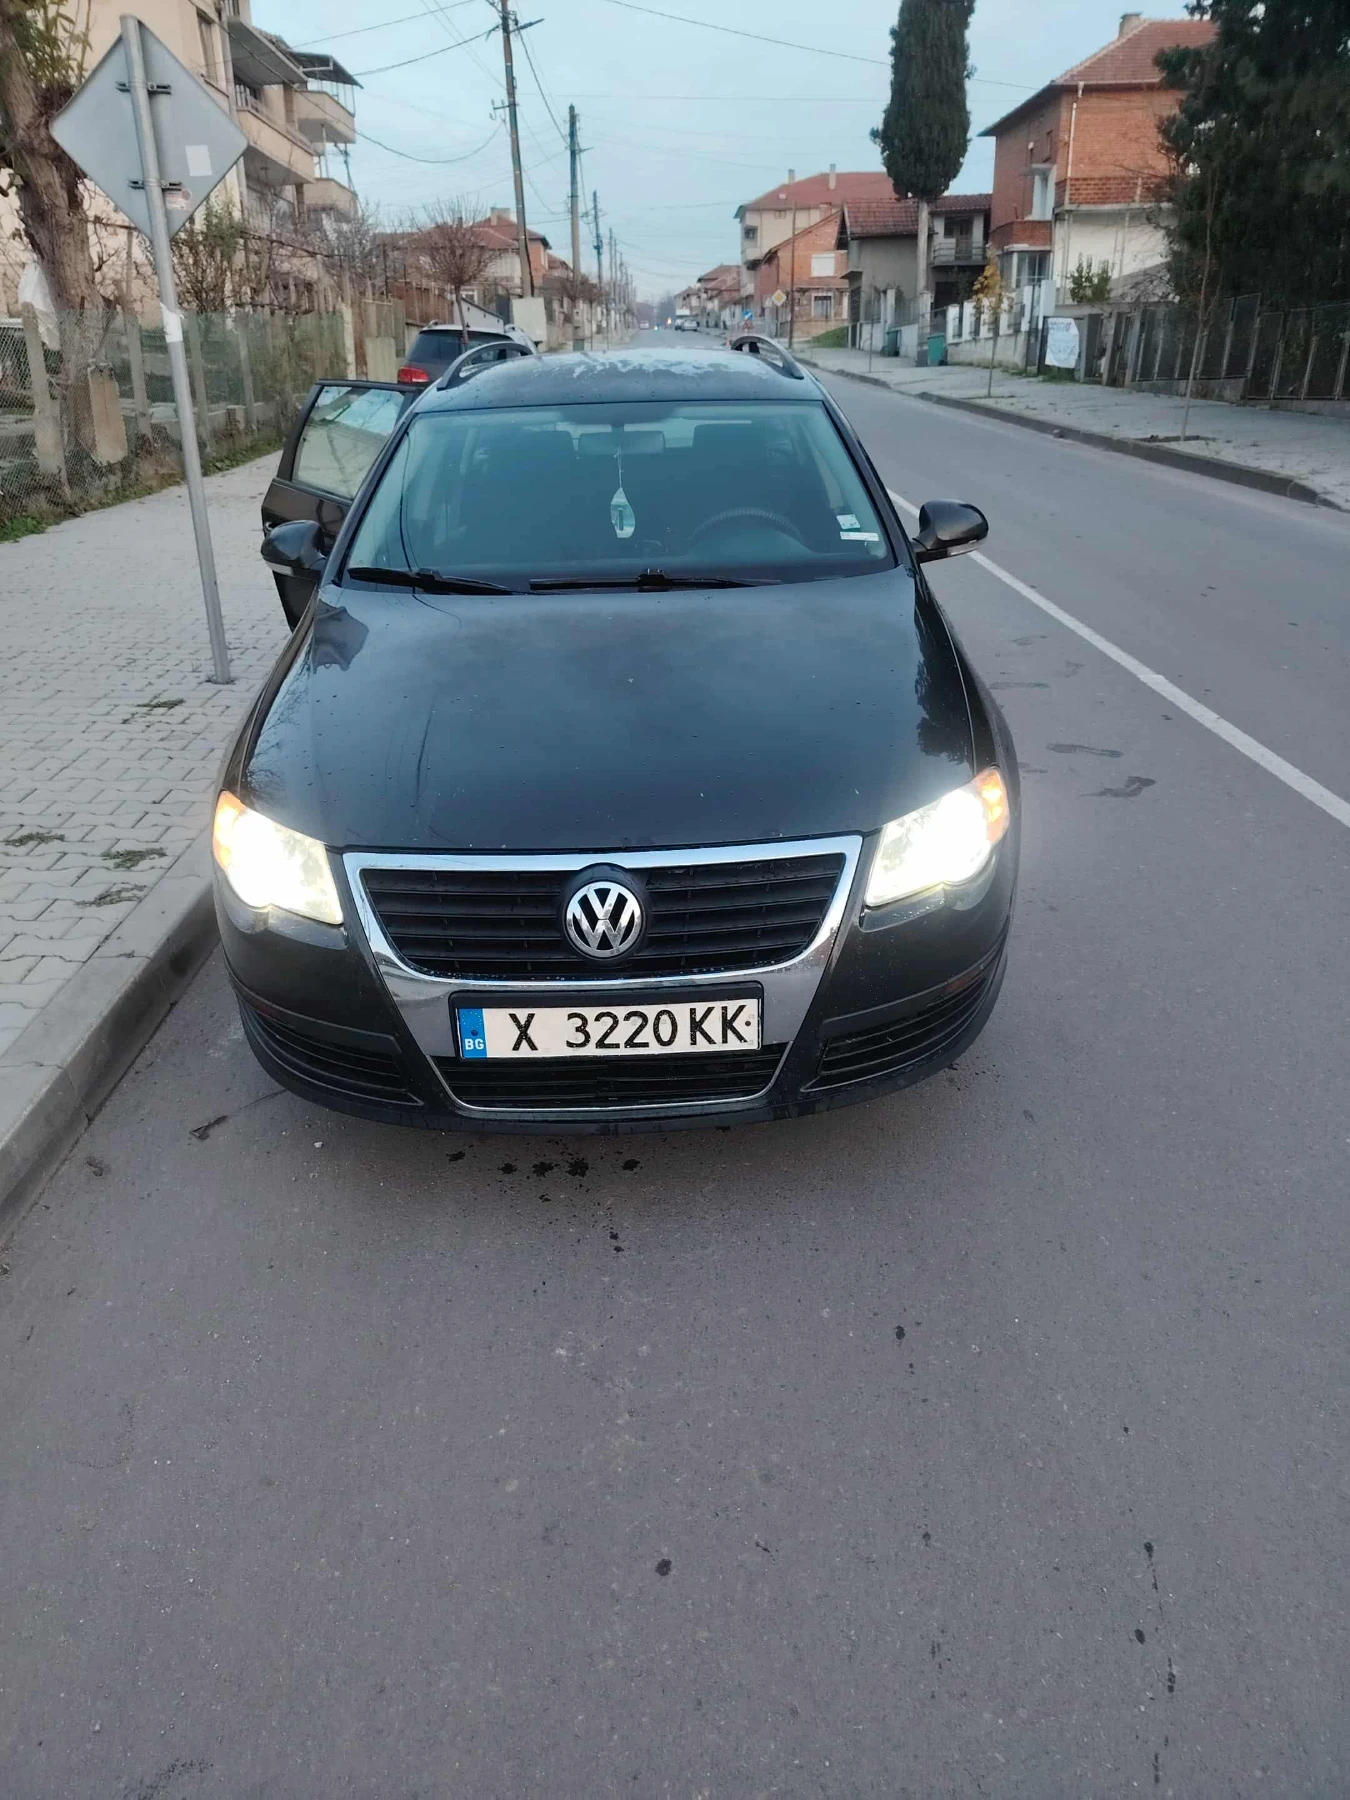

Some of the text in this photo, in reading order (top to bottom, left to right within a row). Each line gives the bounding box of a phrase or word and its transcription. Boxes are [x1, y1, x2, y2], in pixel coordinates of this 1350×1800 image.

[566, 881, 641, 958] VW
[464, 1038, 485, 1051] BG
[508, 1004, 749, 1051] X 3220 KK
